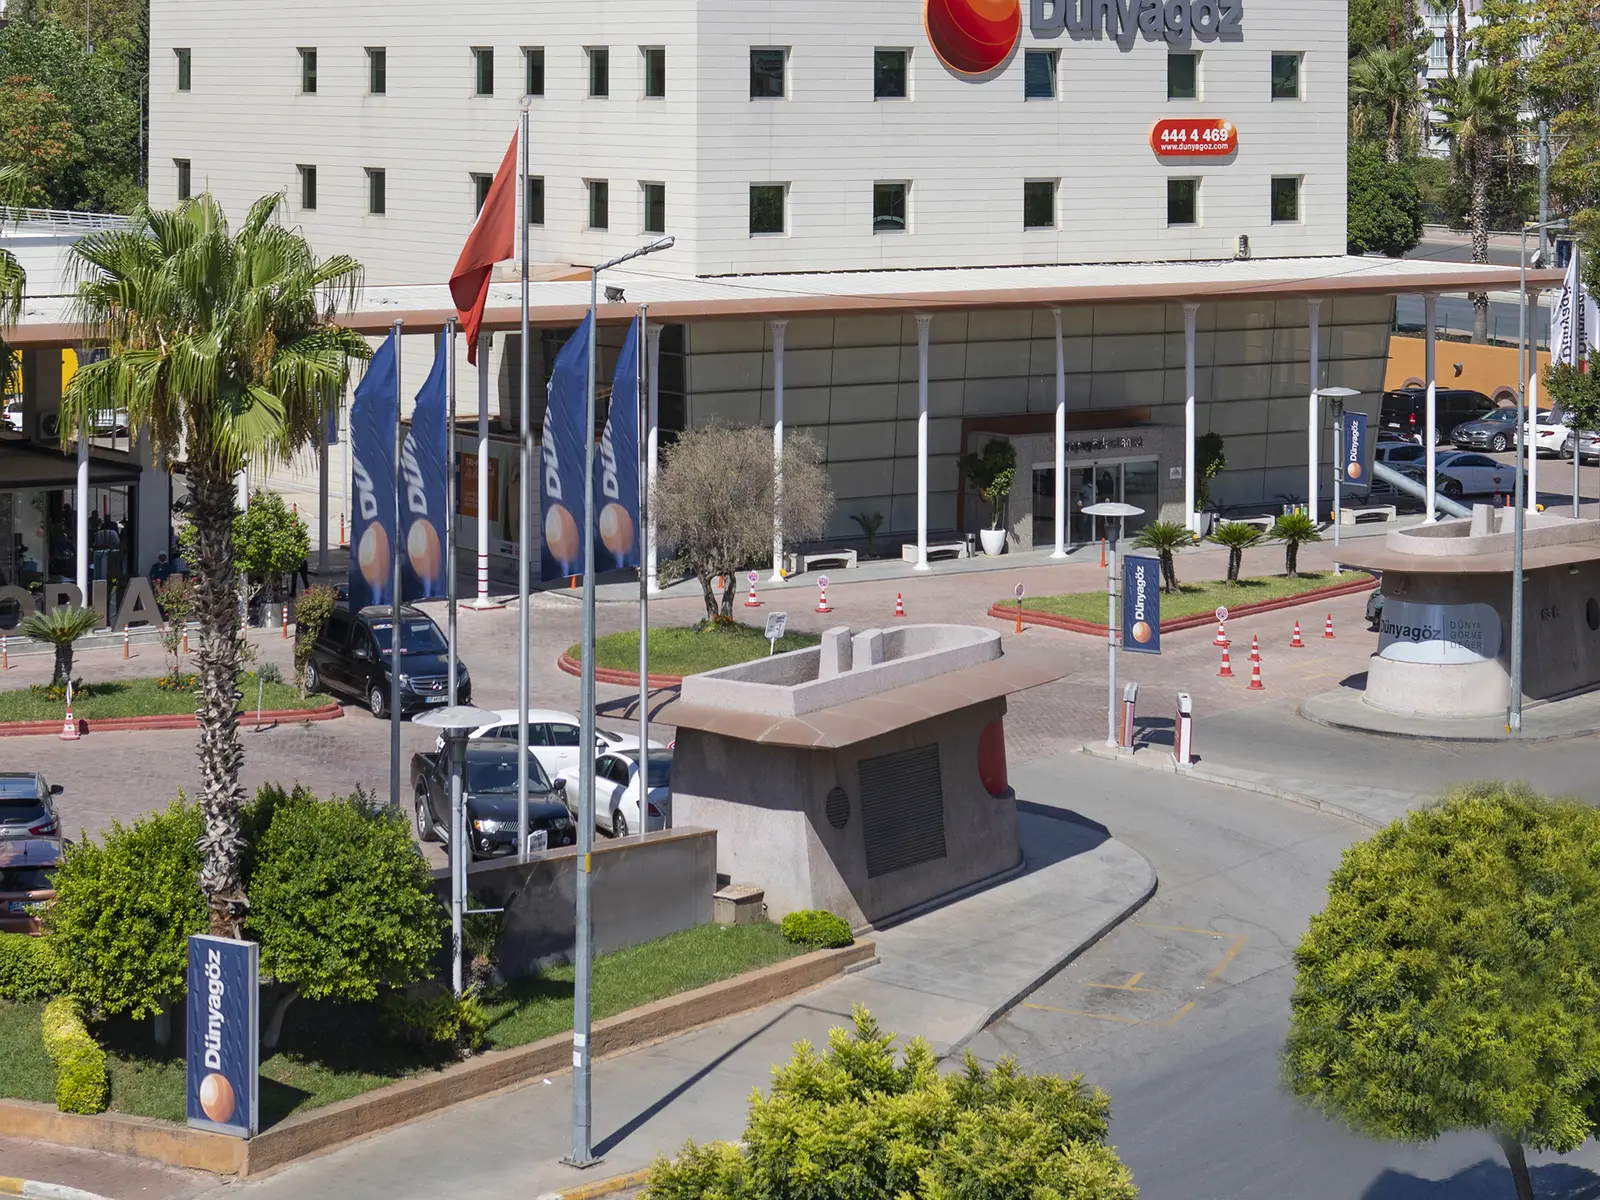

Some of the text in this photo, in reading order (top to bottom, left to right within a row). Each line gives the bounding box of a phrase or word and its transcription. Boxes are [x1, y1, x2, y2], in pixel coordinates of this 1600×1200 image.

[1160, 128, 1229, 142] 444 4 469
[1160, 142, 1229, 152] www.dunyagoz.com
[1349, 420, 1360, 462] Dünyagöz
[1135, 565, 1147, 621] Dünyagöz
[1381, 619, 1442, 641] Dünyagöz
[1449, 619, 1481, 629] DÜNYA
[1450, 639, 1482, 649] DEĞER
[204, 948, 225, 1071] Dünyagöz
